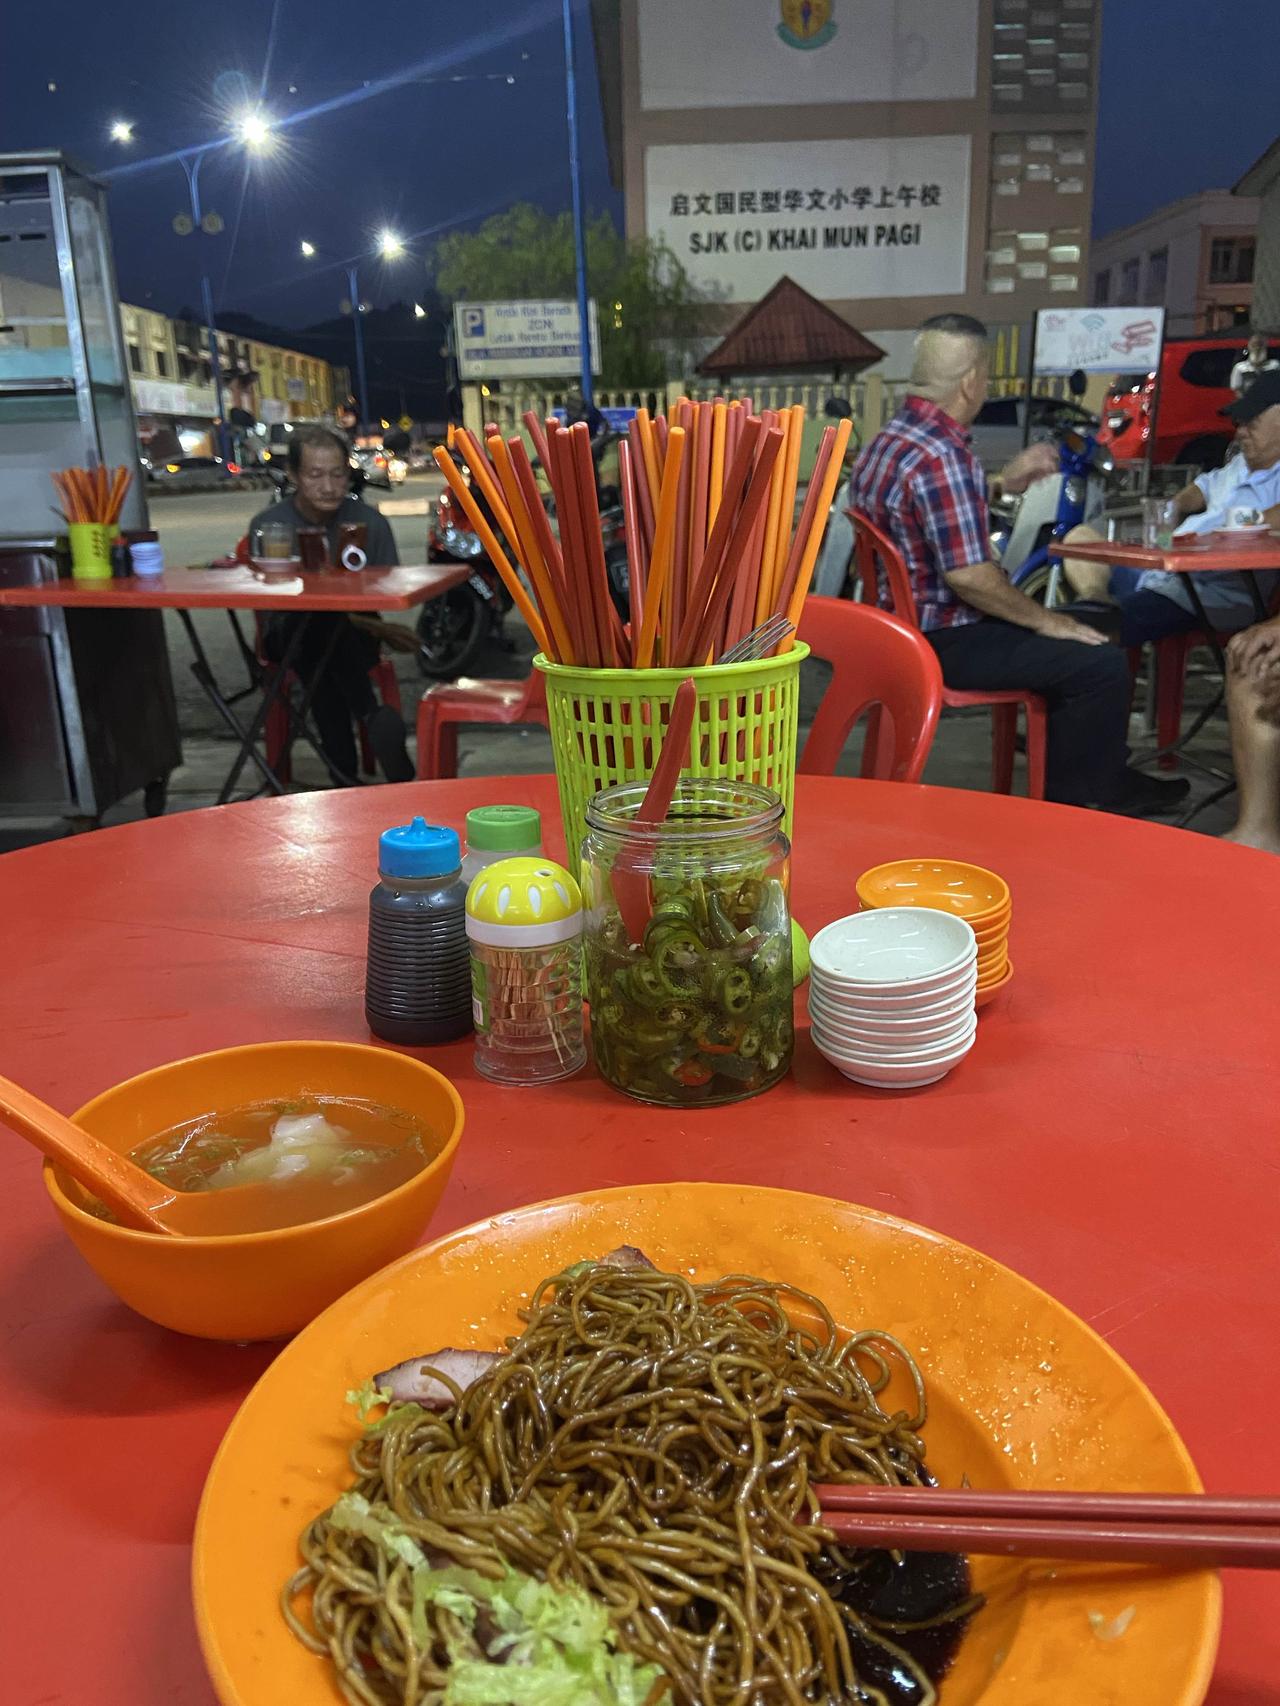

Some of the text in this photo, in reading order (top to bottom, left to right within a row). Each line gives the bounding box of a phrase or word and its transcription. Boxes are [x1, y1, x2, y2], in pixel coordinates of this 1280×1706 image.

[669, 184, 942, 216] 启文国民型华文小学上午校
[690, 223, 921, 254] SJK (C) KHAI MUN PAGI
